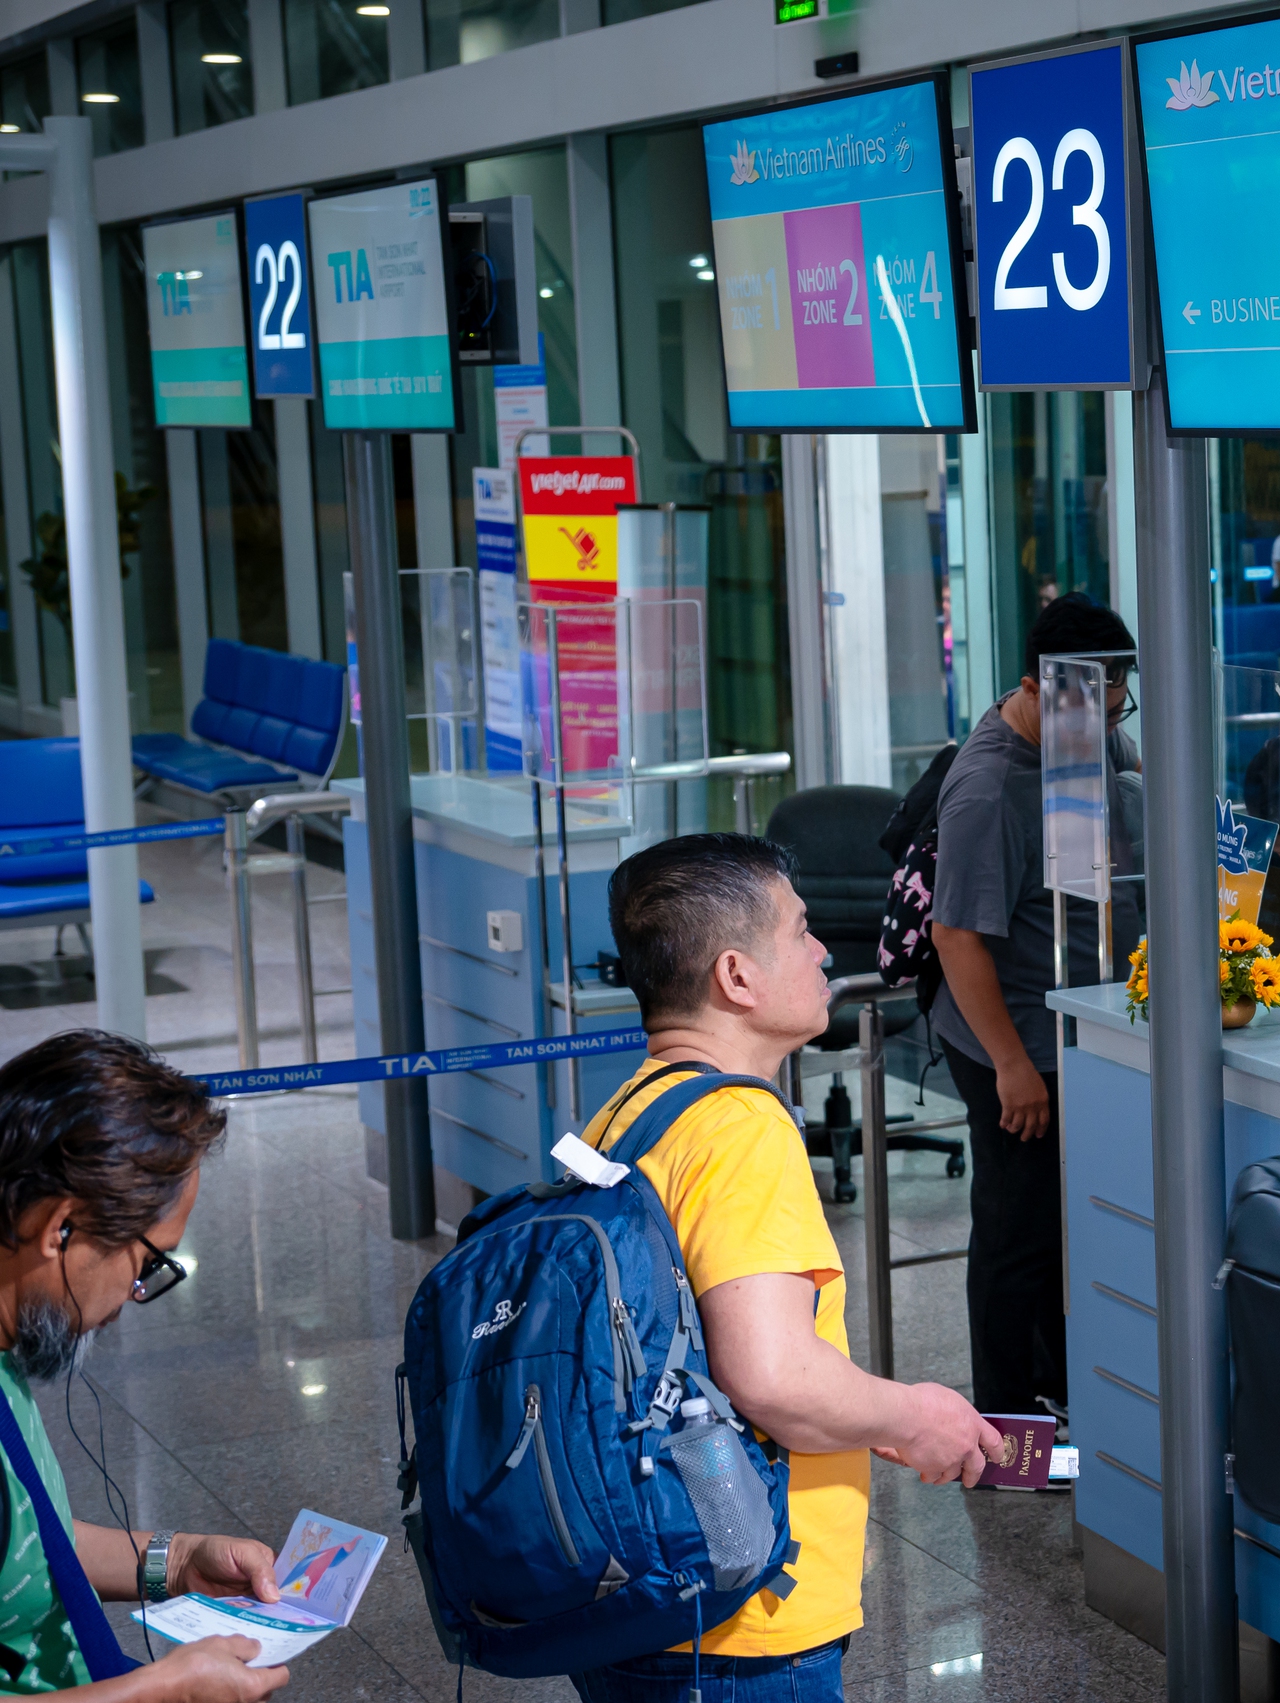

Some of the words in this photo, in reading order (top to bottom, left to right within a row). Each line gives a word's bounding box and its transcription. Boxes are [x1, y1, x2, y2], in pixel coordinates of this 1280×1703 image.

[758, 147, 825, 181] Vietnam
[825, 132, 887, 172] Airlines
[991, 127, 1112, 312] 23
[255, 239, 307, 351] 22
[327, 248, 375, 303] TIA
[725, 270, 763, 298] NHÓM
[765, 266, 780, 331] 1
[796, 262, 838, 293] NHÓM
[839, 258, 863, 326] 2
[919, 250, 943, 320] 4
[730, 306, 764, 331] ZONE
[802, 299, 838, 325] ZONE
[378, 1055, 438, 1076] TIA
[505, 1044, 533, 1059] TAN
[537, 1041, 567, 1056] SON
[570, 1037, 606, 1051] NHAT
[246, 1073, 280, 1087] SƠN
[1019, 1429, 1035, 1476] PASAPORTE
[237, 1610, 271, 1626] Economy
[270, 1620, 289, 1630] Class
